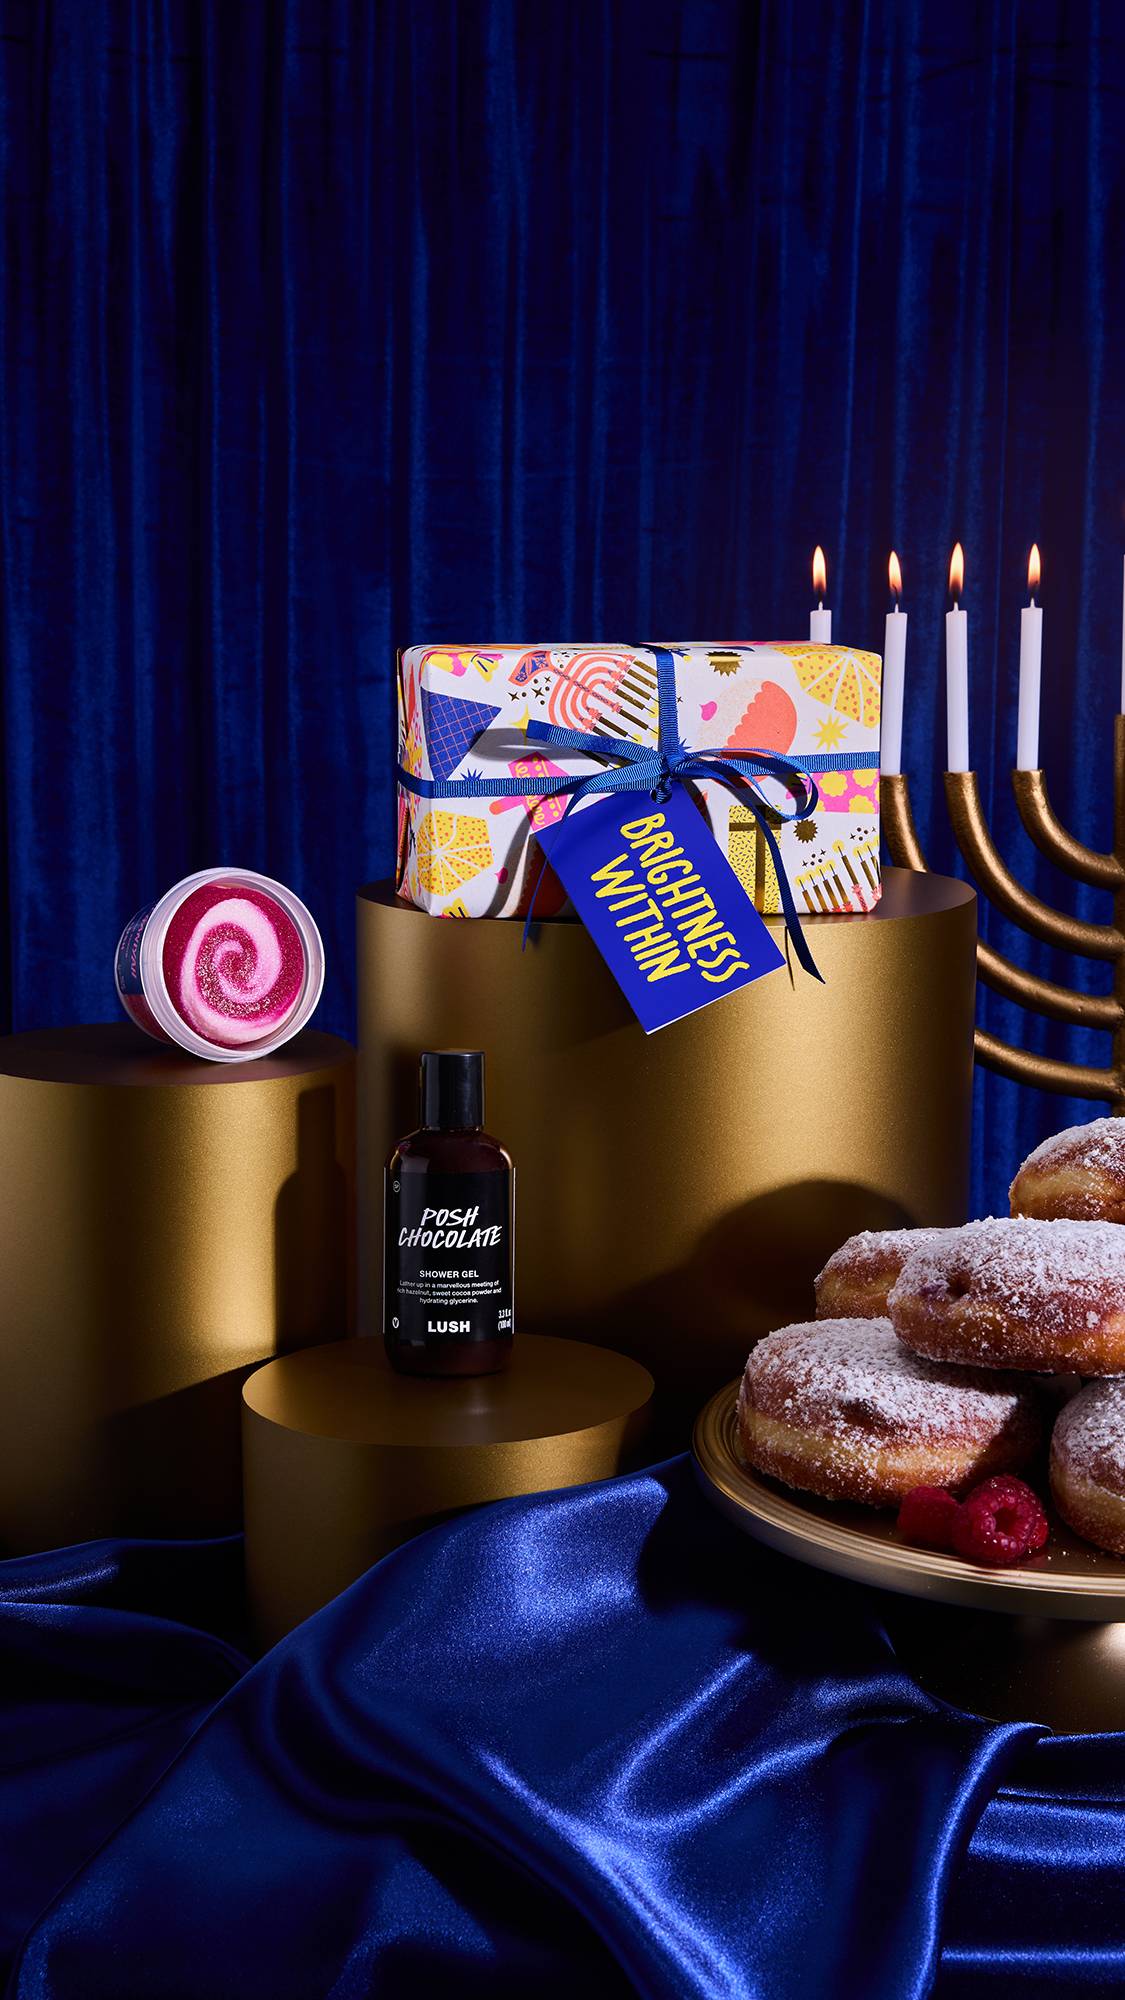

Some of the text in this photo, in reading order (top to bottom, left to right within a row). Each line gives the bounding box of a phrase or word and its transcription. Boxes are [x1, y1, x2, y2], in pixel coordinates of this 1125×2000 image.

[620, 813, 750, 983] BRIGHTNESS
[591, 853, 691, 982] WITHIN
[420, 1205, 480, 1227] POSH
[398, 1225, 503, 1249] CHOCOLATE
[419, 1270, 480, 1279] SHOWER GEL
[419, 1297, 449, 1306] hydrating
[471, 1289, 493, 1297] powder
[427, 1321, 471, 1333] LUSH
